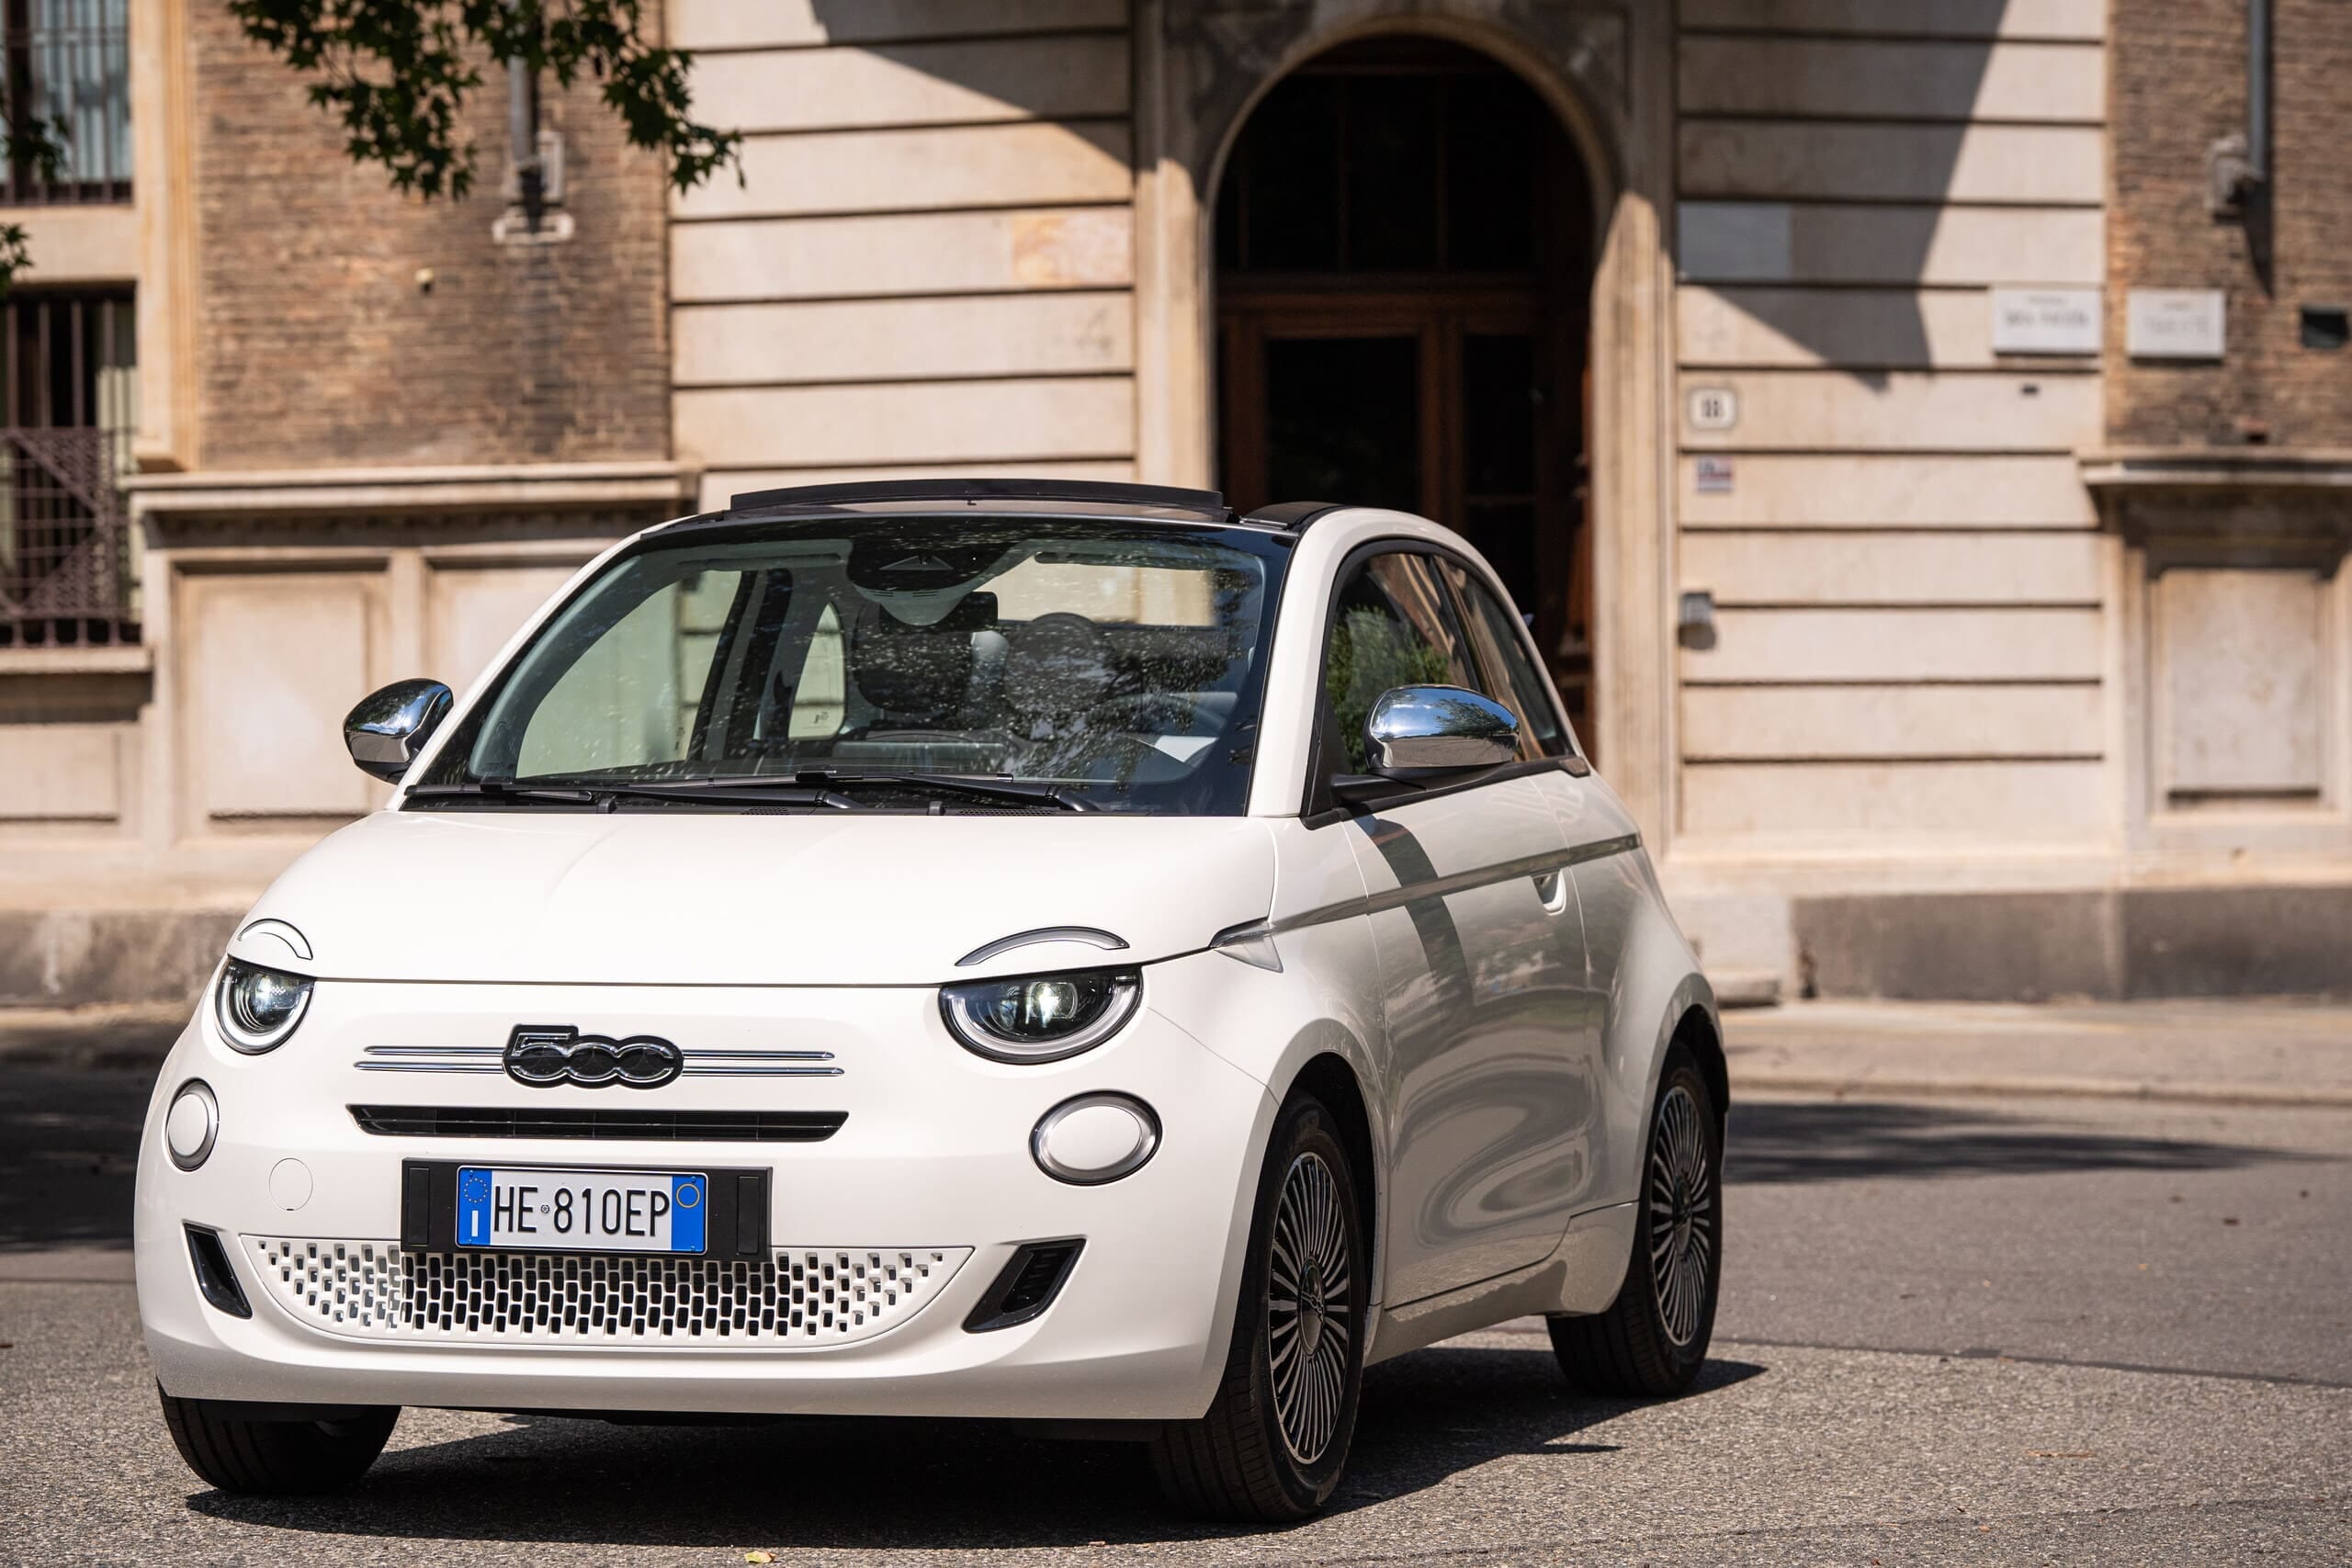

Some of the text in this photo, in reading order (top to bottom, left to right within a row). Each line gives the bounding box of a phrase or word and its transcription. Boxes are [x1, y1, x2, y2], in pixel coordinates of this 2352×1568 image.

[506, 1026, 680, 1088] 500
[470, 1209, 479, 1237] I
[493, 1185, 671, 1237] HE 810EP
